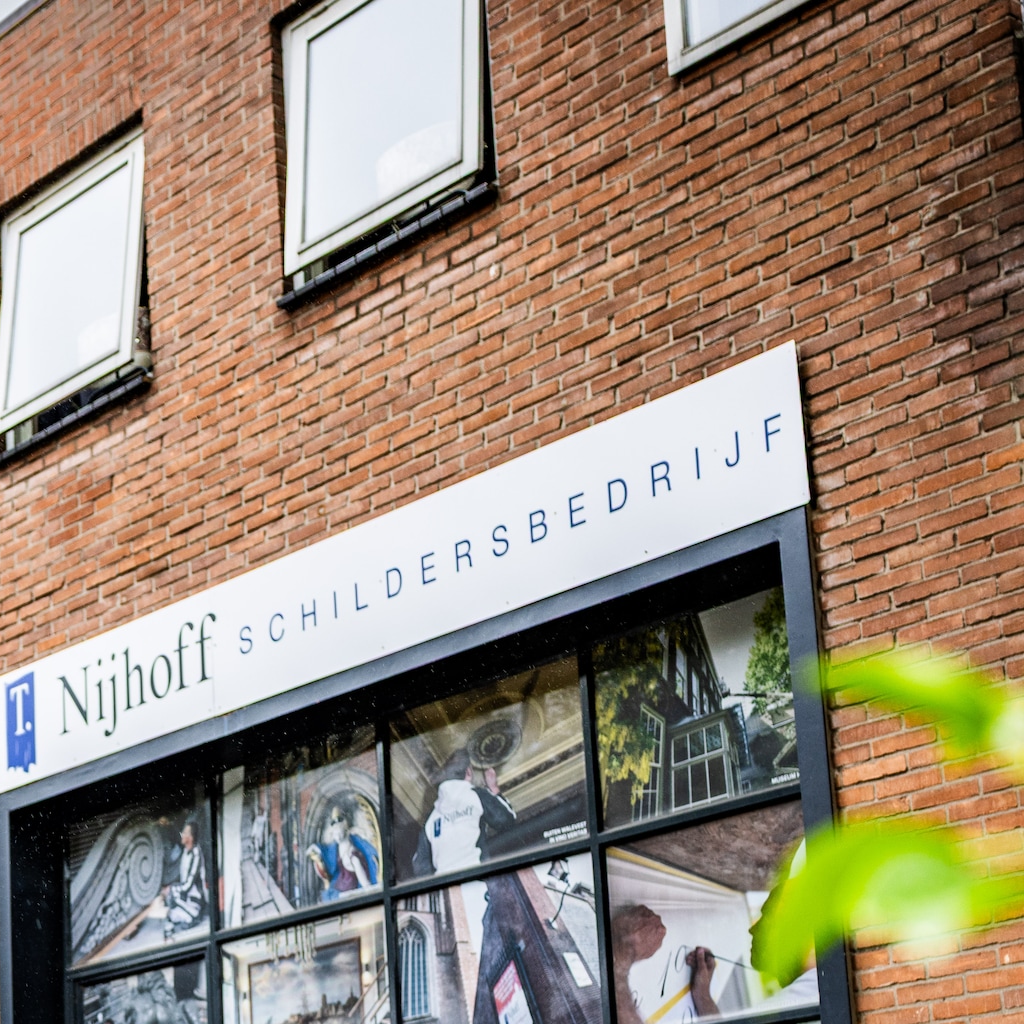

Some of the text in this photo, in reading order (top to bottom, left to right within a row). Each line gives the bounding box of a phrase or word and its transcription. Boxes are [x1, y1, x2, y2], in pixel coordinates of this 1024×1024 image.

[57, 612, 217, 737] Nijhoff
[238, 413, 783, 655] SCHILDERSBEDRIJF
[771, 771, 796, 784] MUSEUM
[443, 804, 475, 825] Nijhoff
